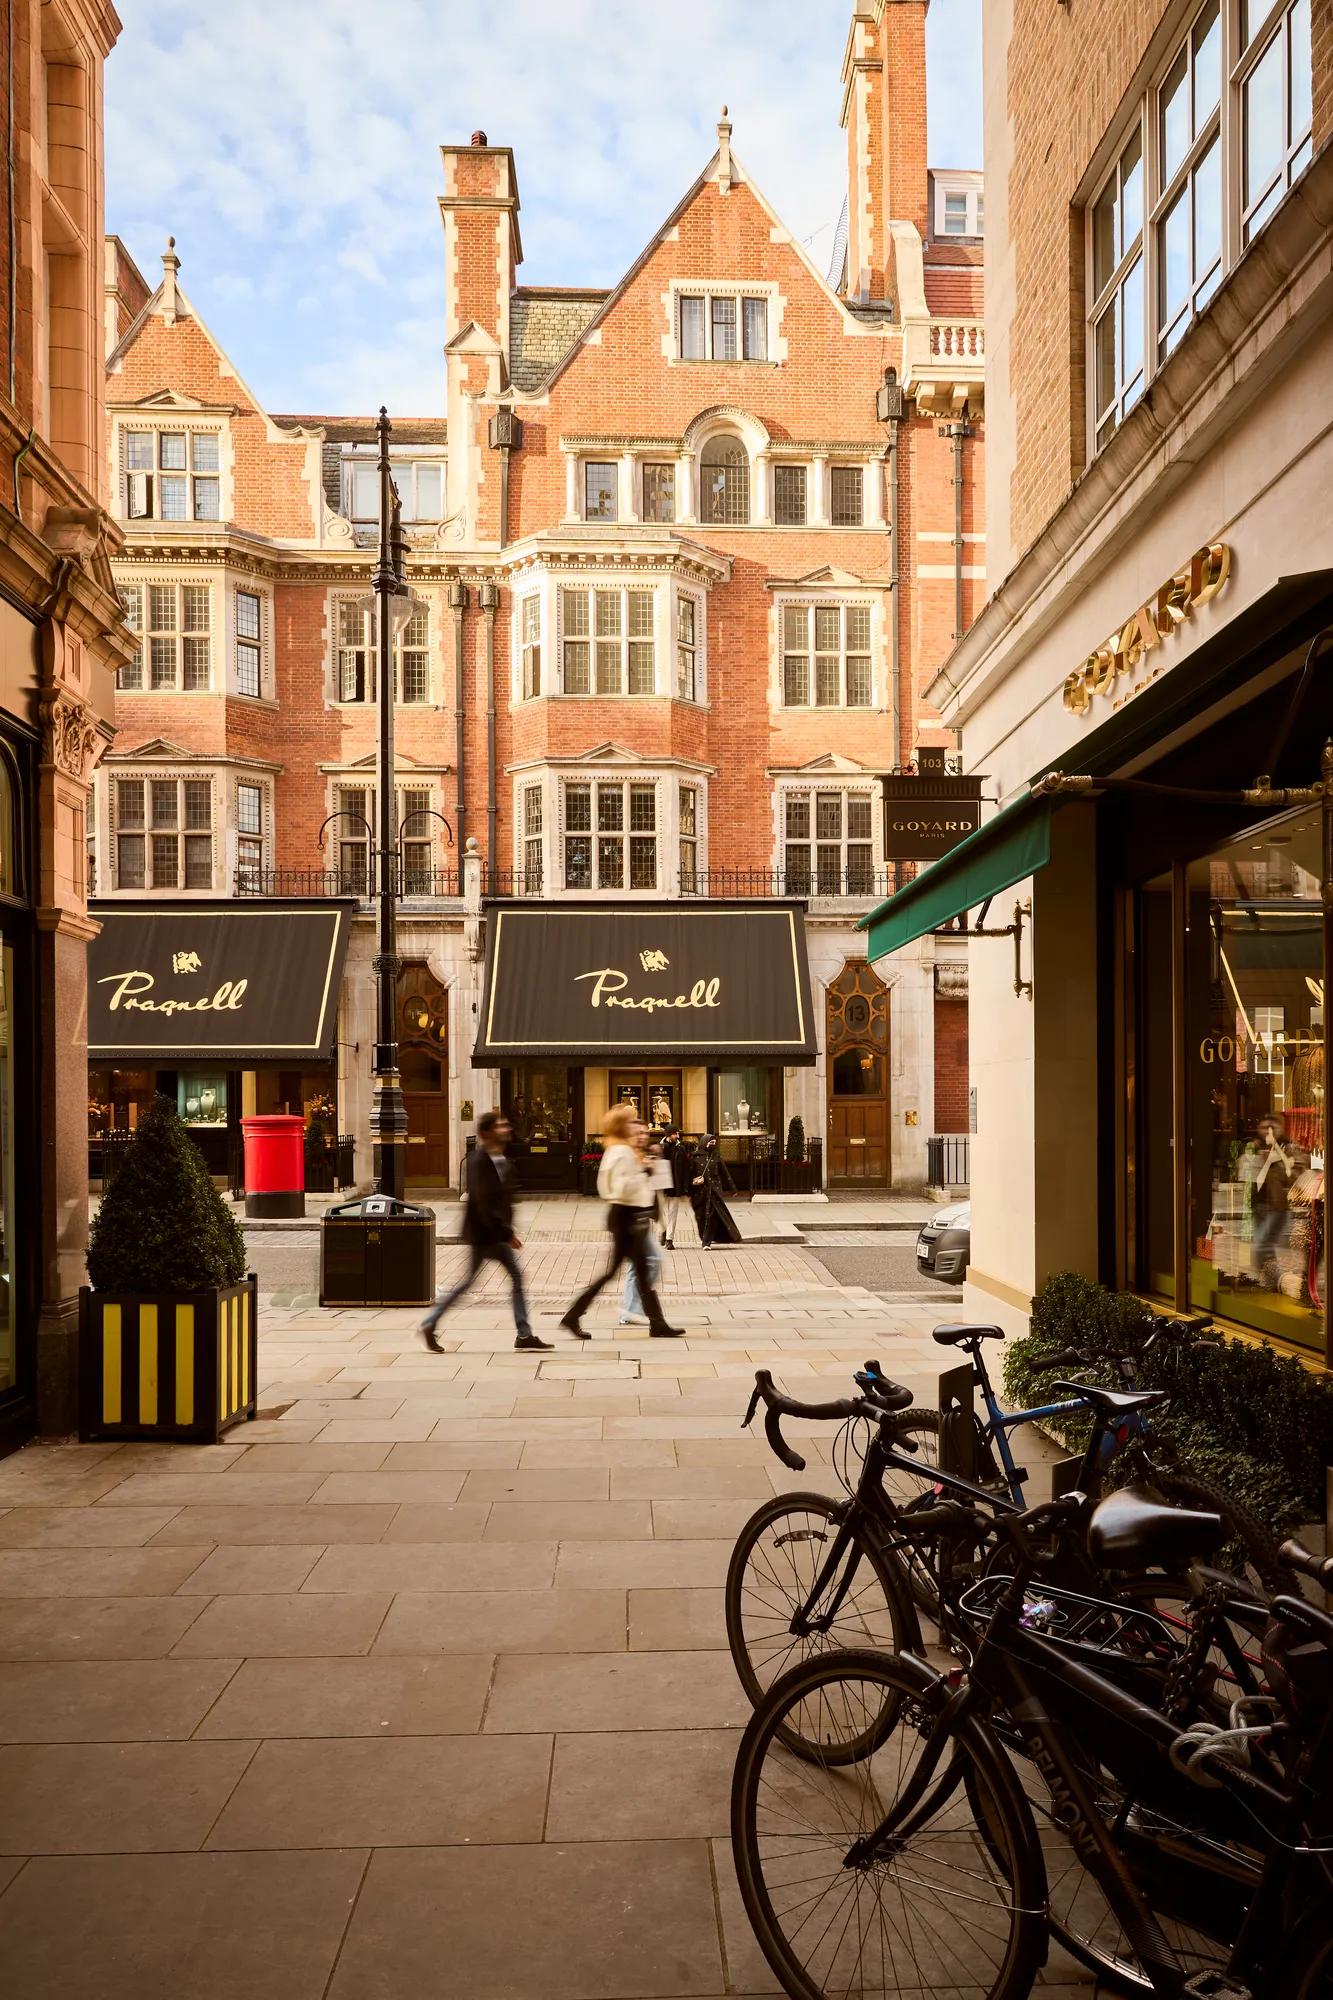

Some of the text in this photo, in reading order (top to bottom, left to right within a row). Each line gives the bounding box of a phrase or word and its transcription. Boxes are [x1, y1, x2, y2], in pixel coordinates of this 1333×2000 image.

[1063, 543, 1231, 716] GOYARD
[922, 759, 942, 768] 103
[892, 821, 972, 831] GOYARD
[97, 970, 248, 1017] Pragnell
[573, 968, 721, 1014] Pragnell
[848, 1004, 866, 1022] 13
[1199, 1027, 1317, 1064] GOYARD
